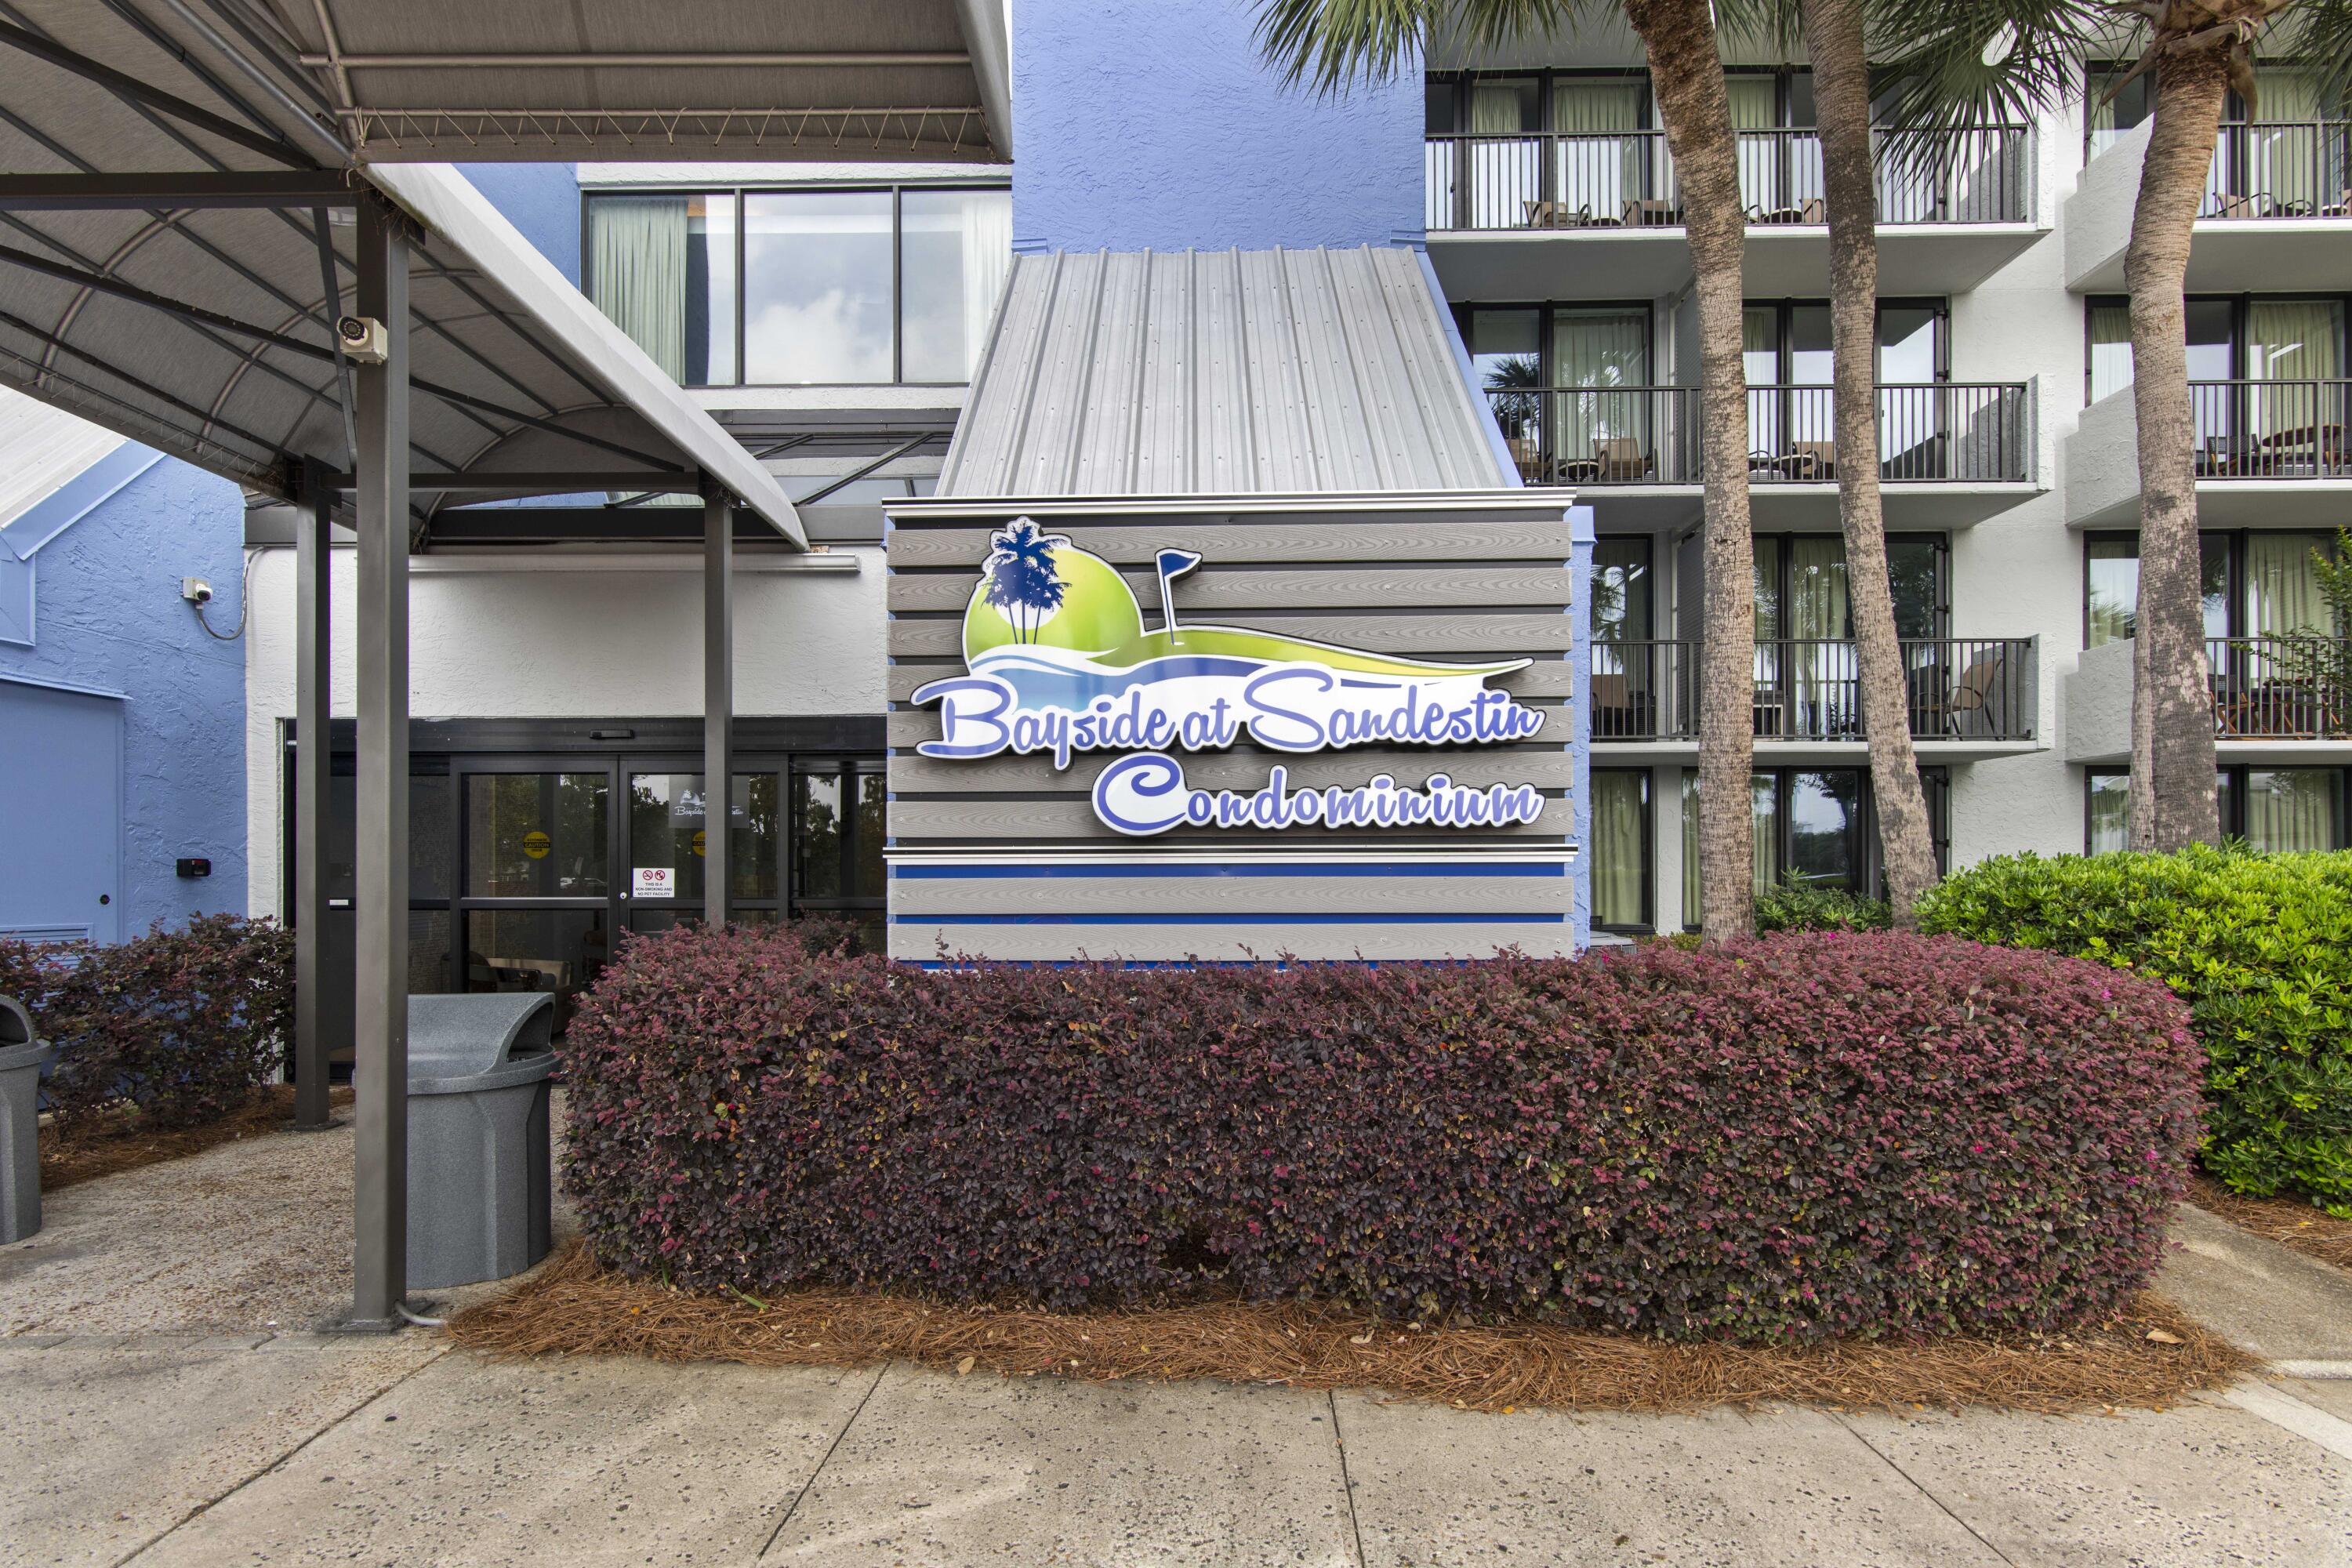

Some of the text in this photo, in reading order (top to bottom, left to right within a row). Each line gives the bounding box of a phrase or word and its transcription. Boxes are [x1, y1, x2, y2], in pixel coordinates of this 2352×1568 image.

[915, 668, 1540, 770] Bayside at Sandestin
[674, 806, 704, 817] Bayside
[1097, 755, 1539, 831] Condominium
